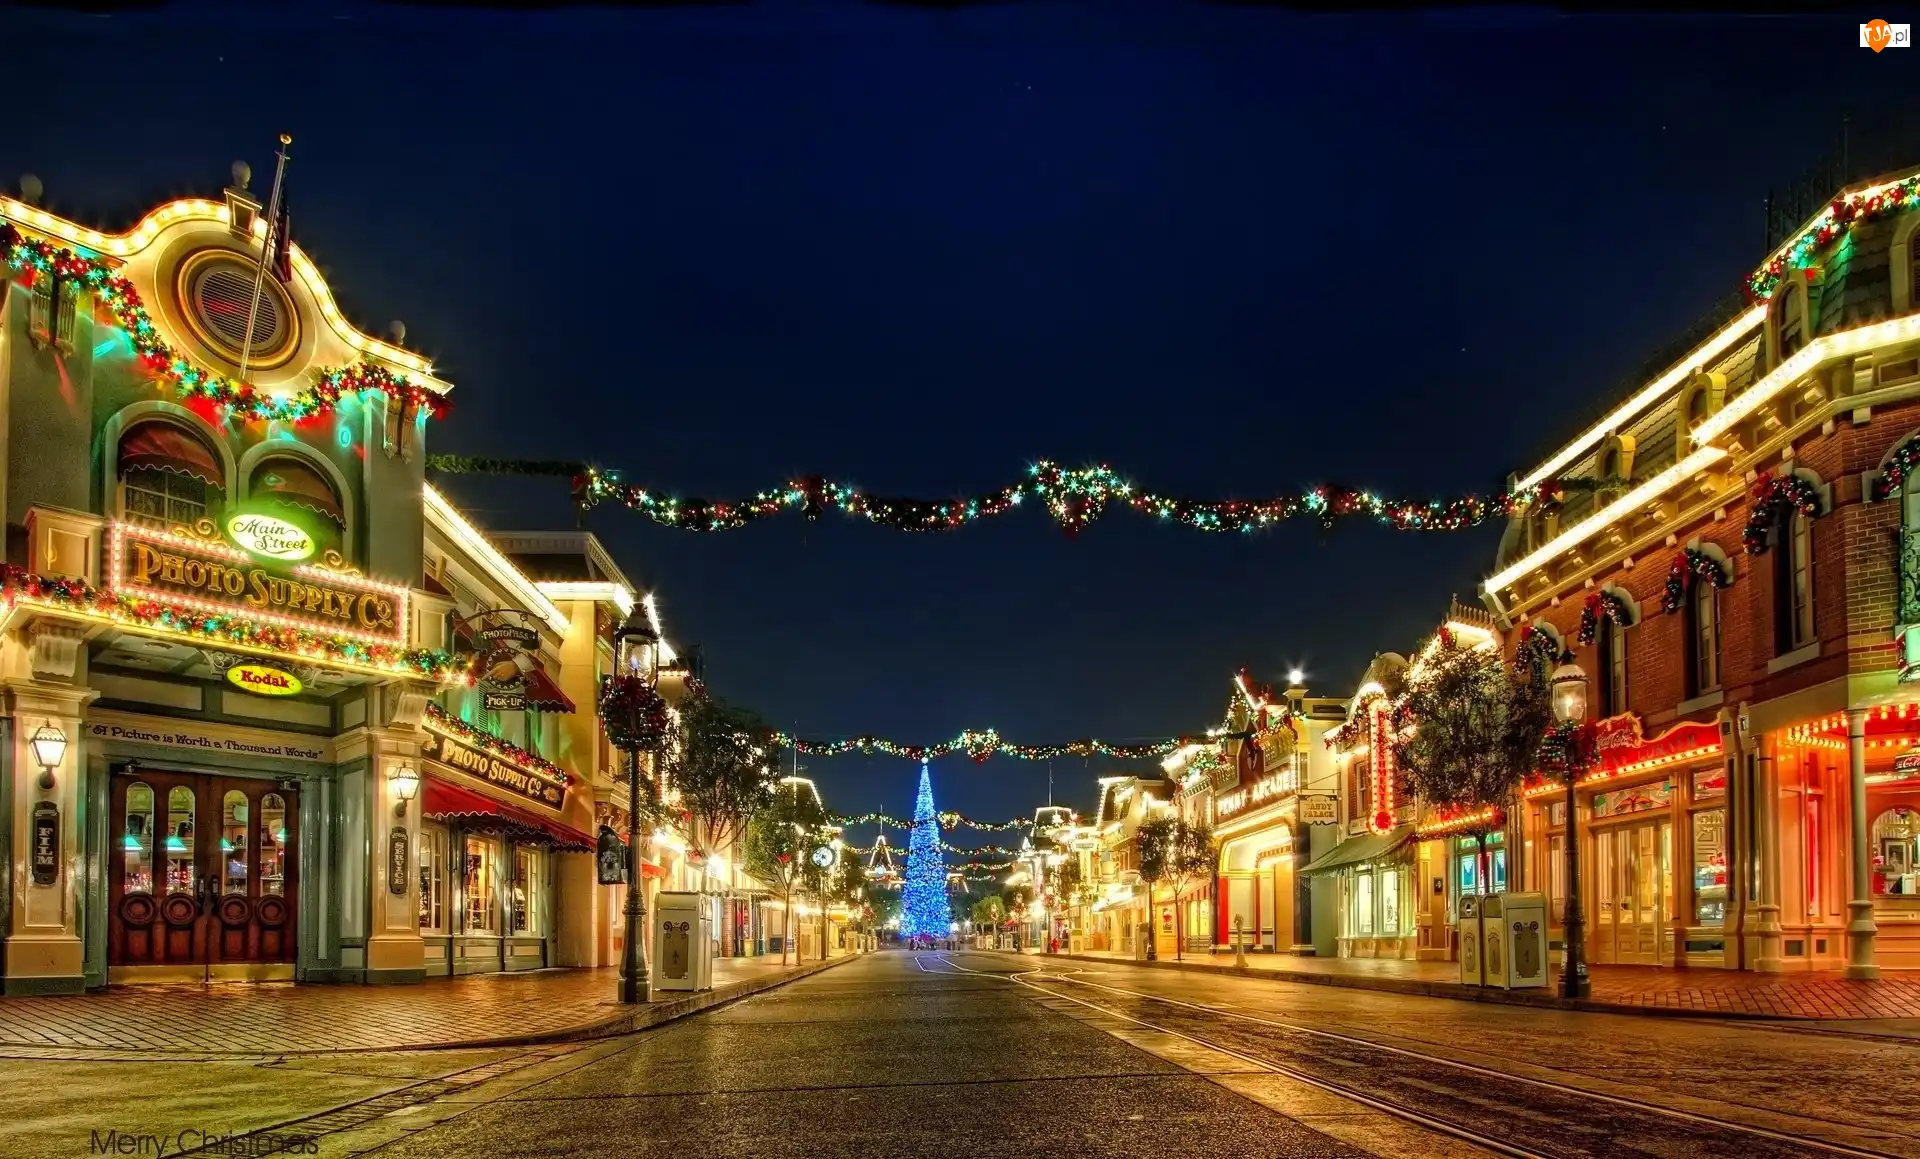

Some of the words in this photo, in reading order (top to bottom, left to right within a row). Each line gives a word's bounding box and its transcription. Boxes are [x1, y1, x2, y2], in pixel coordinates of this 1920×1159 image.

[233, 518, 298, 536] Main
[253, 535, 308, 554] Street
[132, 542, 245, 596] PHOTO
[246, 569, 356, 619] SUPPLY
[241, 670, 289, 689] Kodak
[487, 696, 523, 707] PICK-UP
[111, 726, 160, 742] Picture
[163, 733, 174, 744] is
[174, 734, 211, 748] Worth
[213, 741, 223, 749] a
[224, 740, 282, 755] Thousand
[440, 739, 489, 773] PHOTO
[488, 760, 529, 790] SUPPLY
[37, 827, 54, 865] FILM
[394, 841, 405, 885] SERVICE
